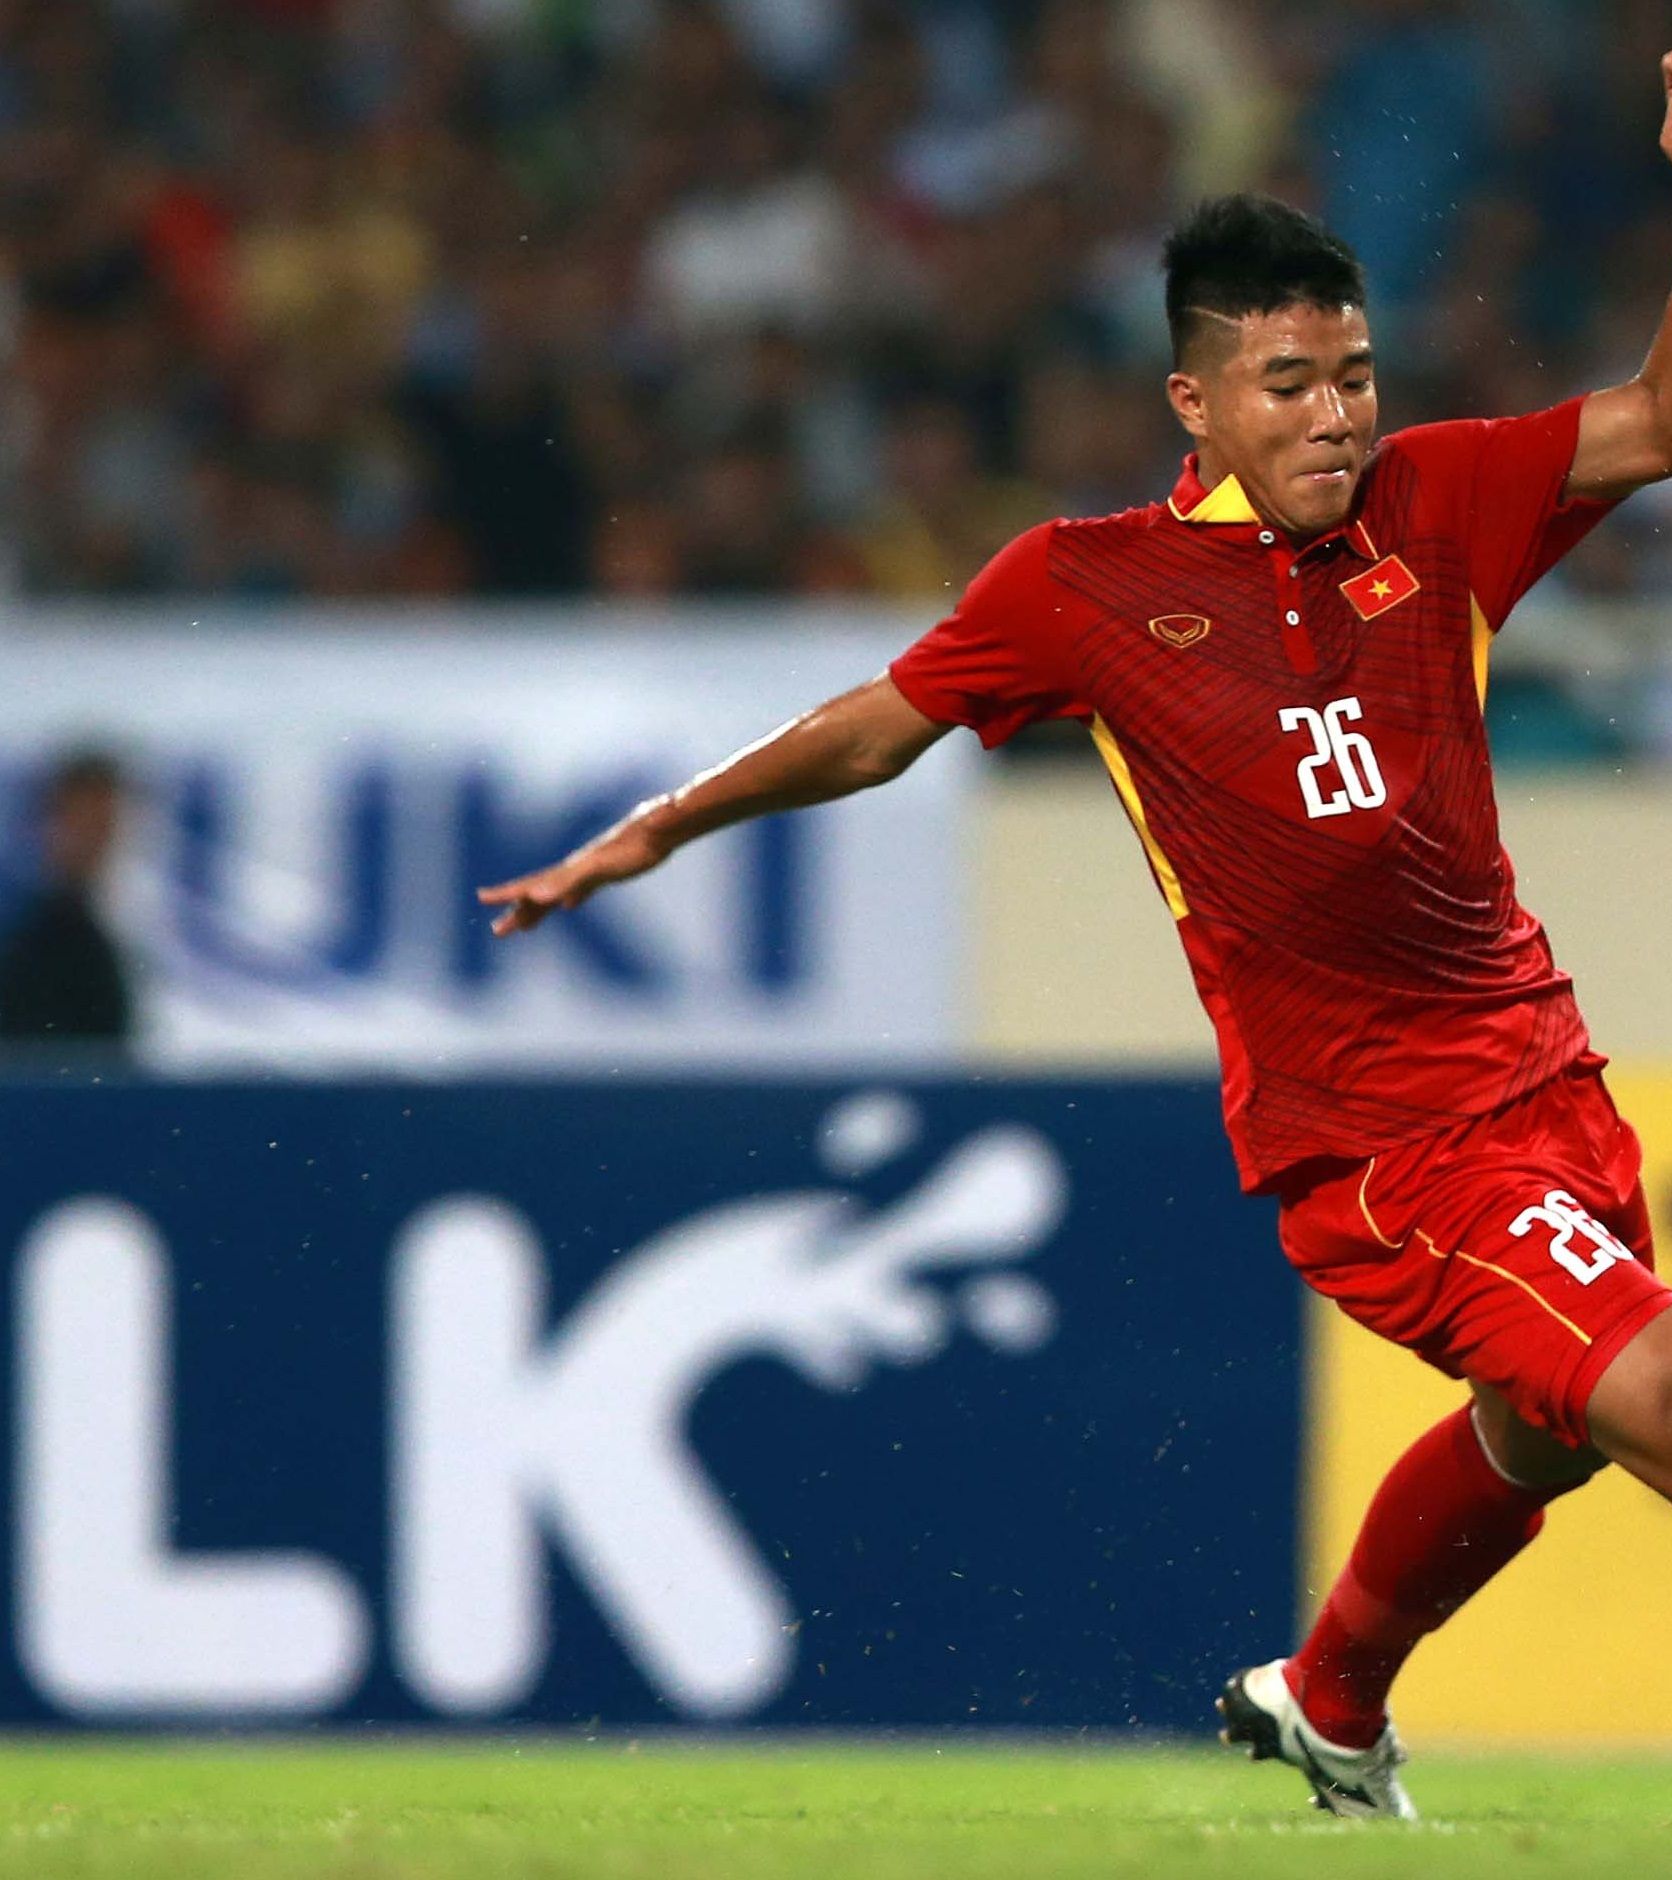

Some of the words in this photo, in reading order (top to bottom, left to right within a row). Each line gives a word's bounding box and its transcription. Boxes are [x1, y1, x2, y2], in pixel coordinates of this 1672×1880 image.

[1278, 697, 1387, 819] 26
[0, 745, 822, 1002] UKI
[1508, 1189, 1634, 1285] 26
